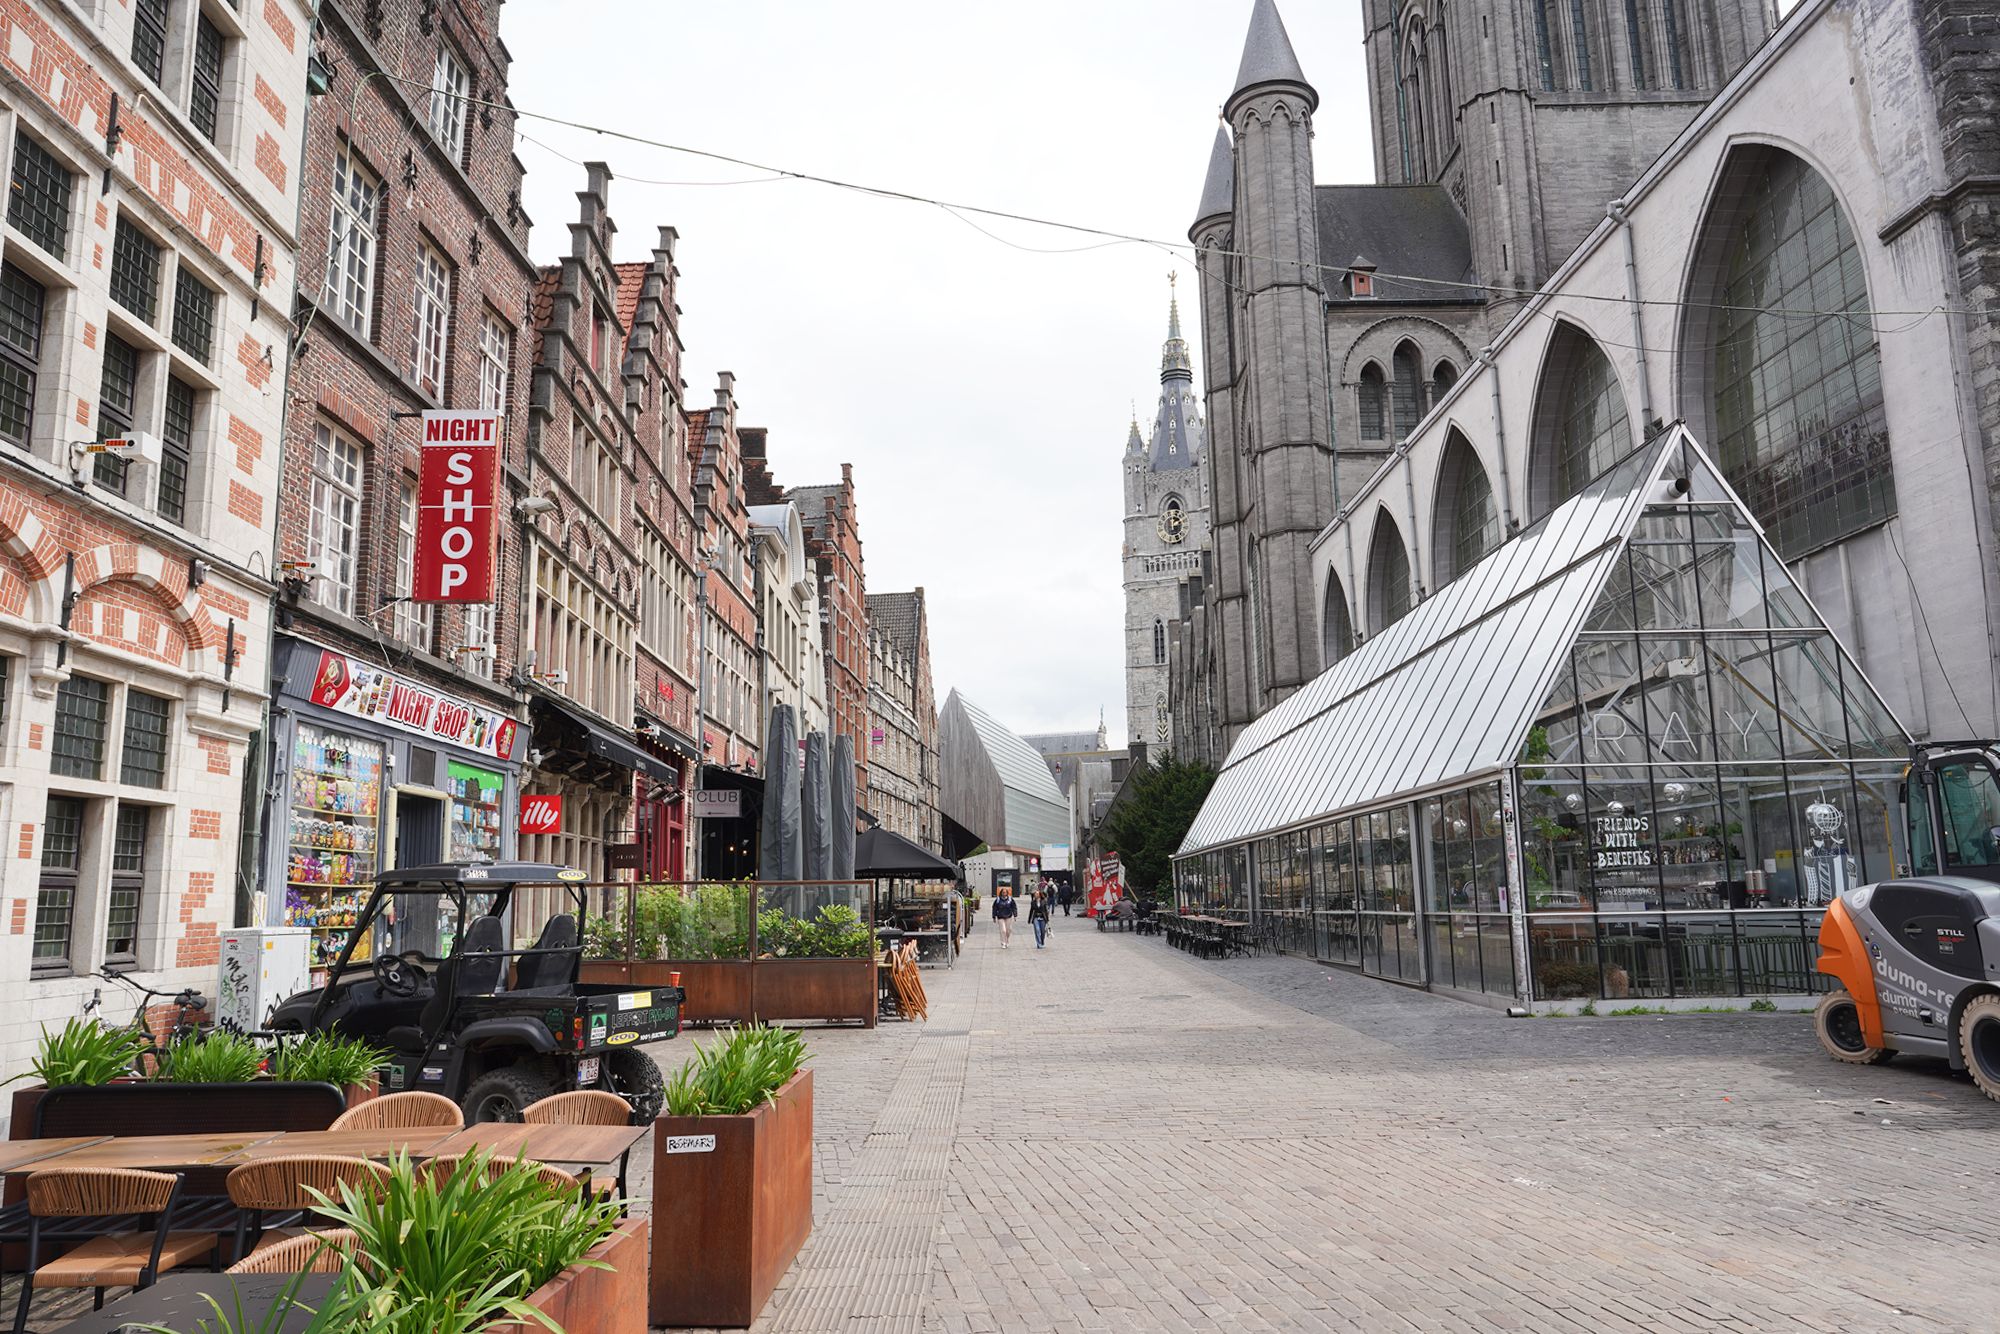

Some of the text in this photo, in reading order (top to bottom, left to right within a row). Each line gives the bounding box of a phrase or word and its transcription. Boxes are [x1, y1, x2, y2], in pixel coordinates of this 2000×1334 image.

[426, 419, 494, 442] NIGHT
[440, 452, 474, 597] SHOP
[388, 682, 470, 742] NIGHT SHOP
[1594, 709, 1758, 756] RAY
[696, 791, 738, 803] CLUB
[523, 800, 558, 830] illy
[1597, 816, 1649, 832] FRIENDS
[1605, 832, 1638, 848] WITH
[1597, 850, 1651, 867] BENEFITS
[1937, 928, 1965, 937] STILL
[1882, 989, 1917, 1009] duma
[610, 1033, 636, 1043] ROB
